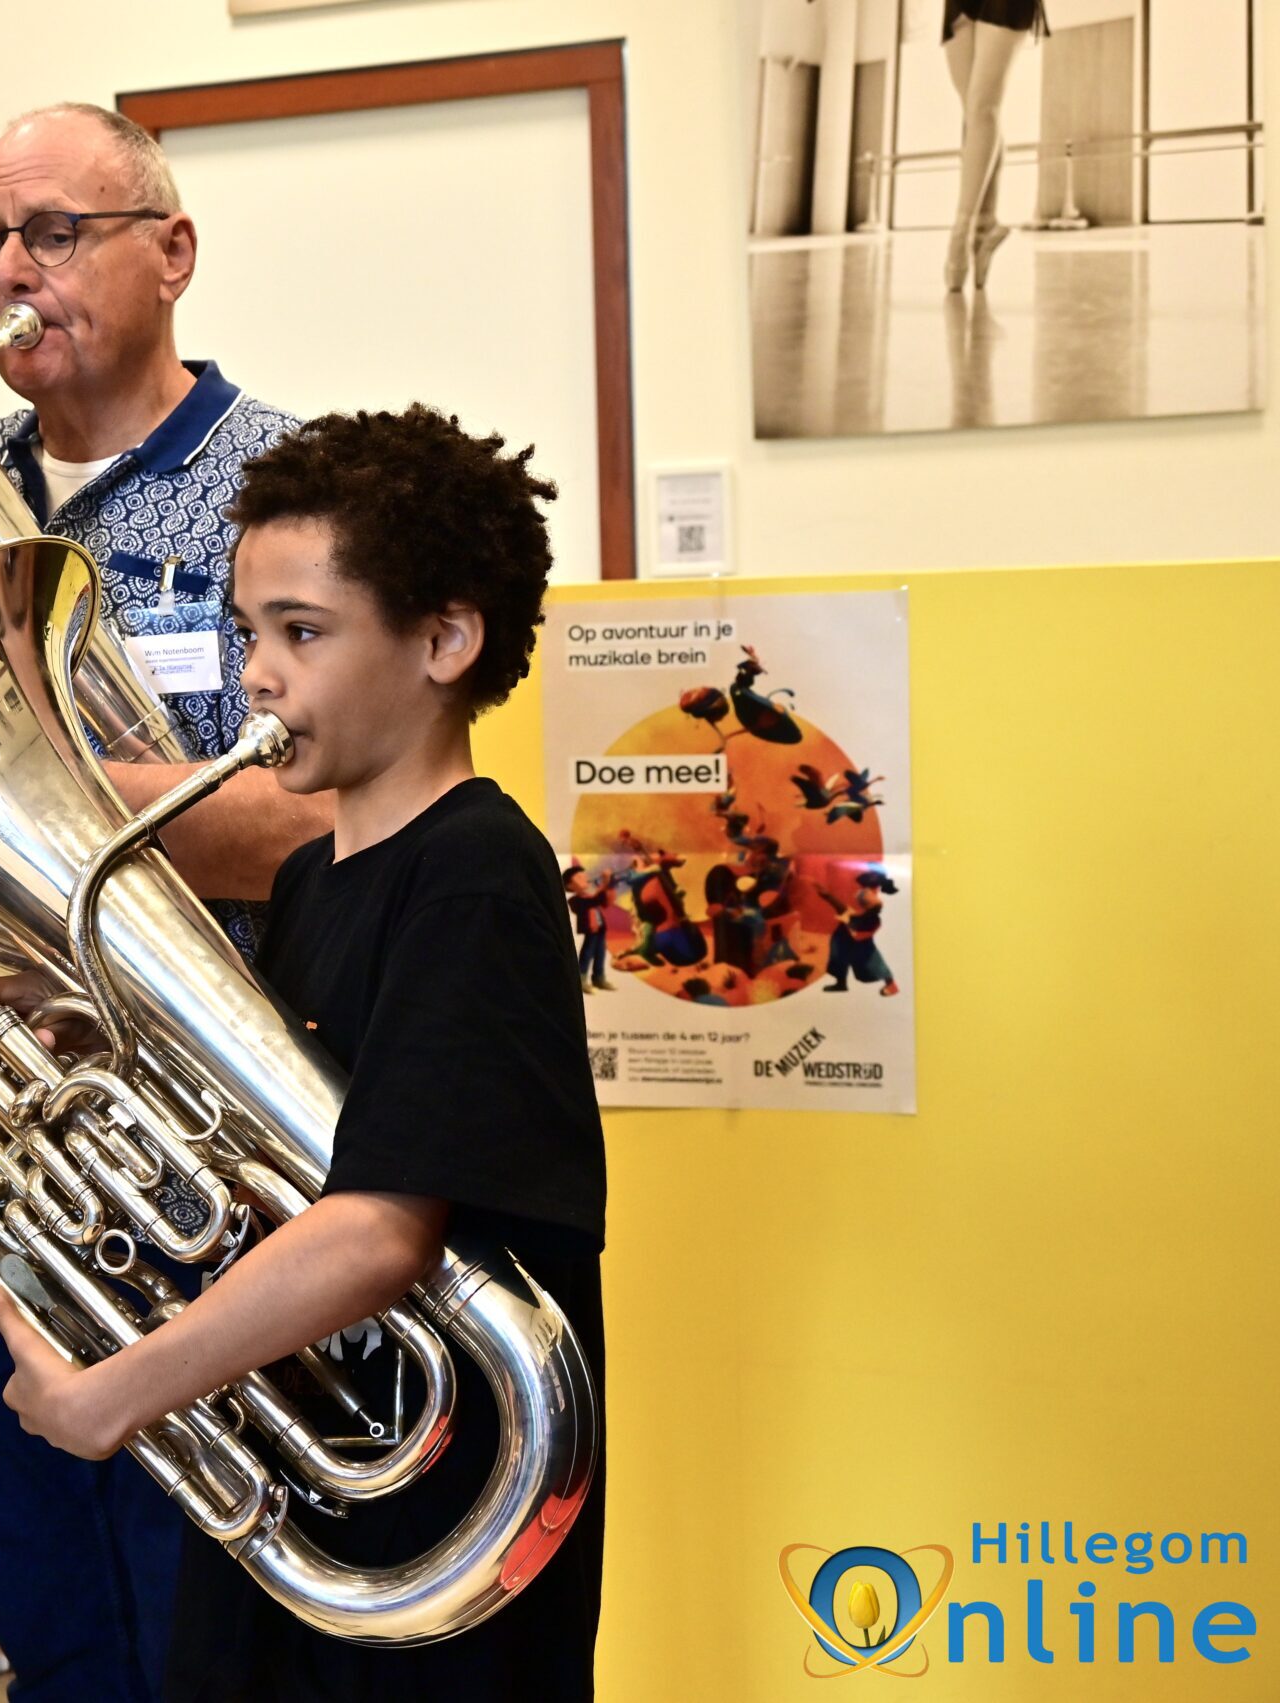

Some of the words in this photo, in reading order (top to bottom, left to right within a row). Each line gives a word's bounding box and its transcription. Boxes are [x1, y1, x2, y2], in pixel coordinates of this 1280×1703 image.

[568, 624, 596, 643] Op
[602, 623, 688, 641] avontuur
[694, 621, 710, 638] in
[714, 619, 733, 641] je
[162, 646, 204, 656] Notenboom
[568, 649, 651, 667] muzikale
[658, 648, 706, 665] brein
[575, 760, 634, 785] Doe
[645, 758, 721, 784] mee!
[608, 1031, 618, 1042] je
[621, 1031, 659, 1040] tussen
[663, 1031, 676, 1041] de
[679, 1032, 687, 1041] 4
[691, 1033, 704, 1041] en
[721, 1032, 750, 1045] jaar?
[774, 1027, 826, 1077] MUZIEK
[753, 1060, 774, 1077] DE
